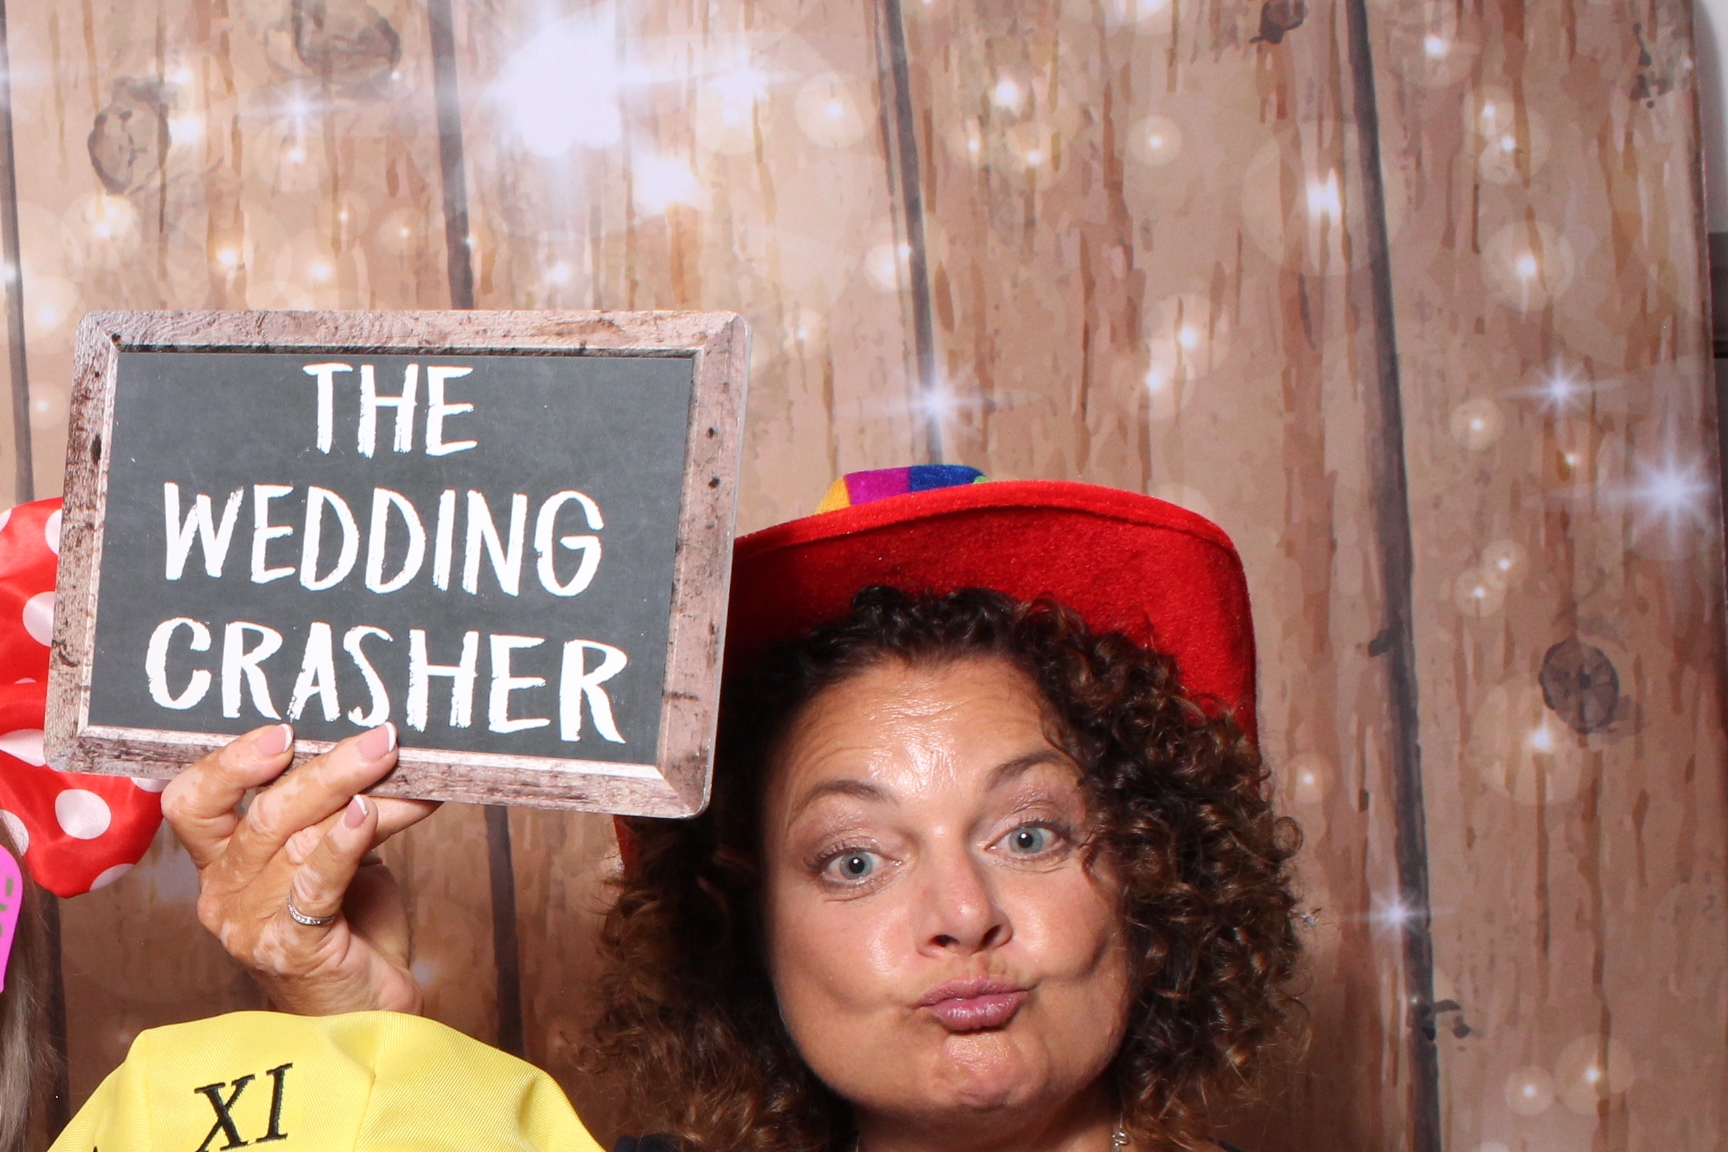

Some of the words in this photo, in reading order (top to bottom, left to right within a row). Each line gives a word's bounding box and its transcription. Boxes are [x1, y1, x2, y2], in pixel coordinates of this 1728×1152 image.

[303, 362, 478, 458] THE
[163, 482, 605, 597] WEDDING
[145, 617, 628, 744] CRASHER
